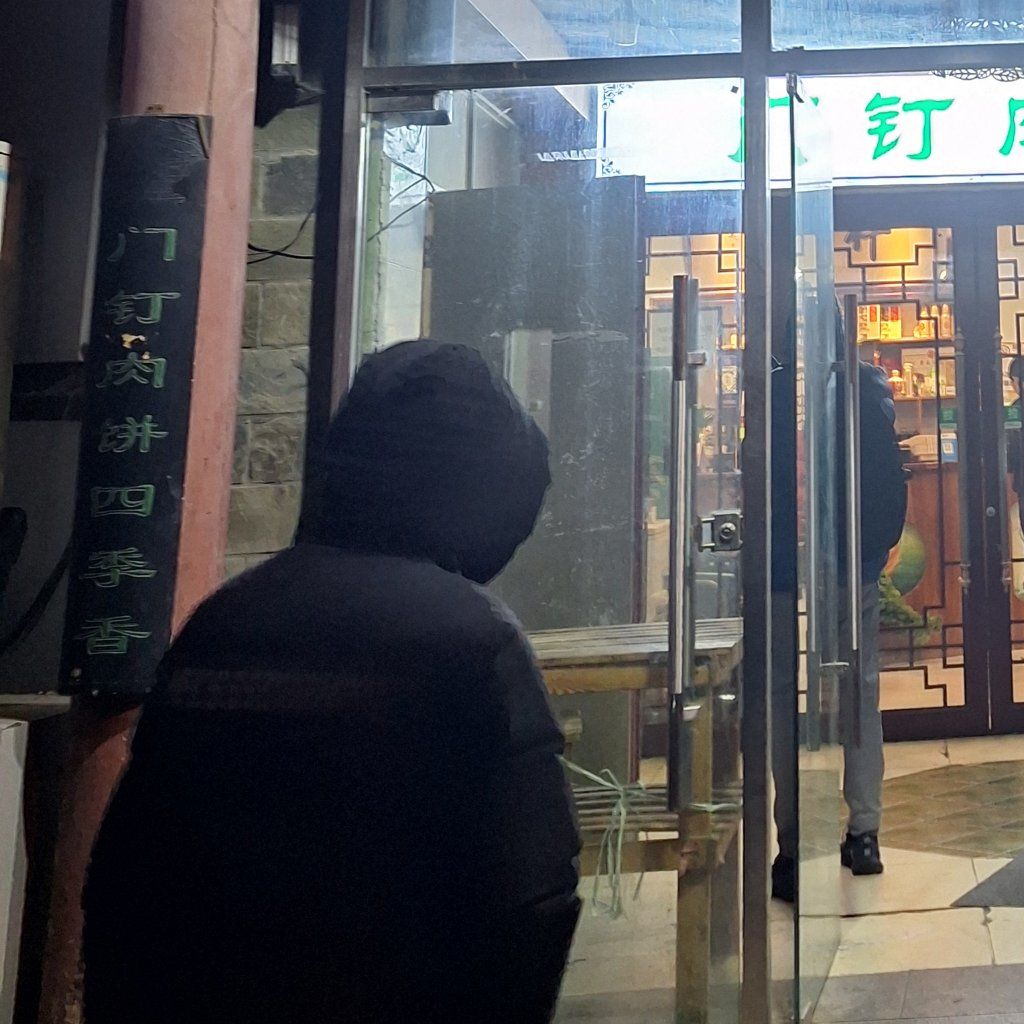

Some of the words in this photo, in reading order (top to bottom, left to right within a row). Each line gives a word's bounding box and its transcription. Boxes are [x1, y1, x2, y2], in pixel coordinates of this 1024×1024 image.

[74, 226, 182, 655] 门钉肉饼四季香
